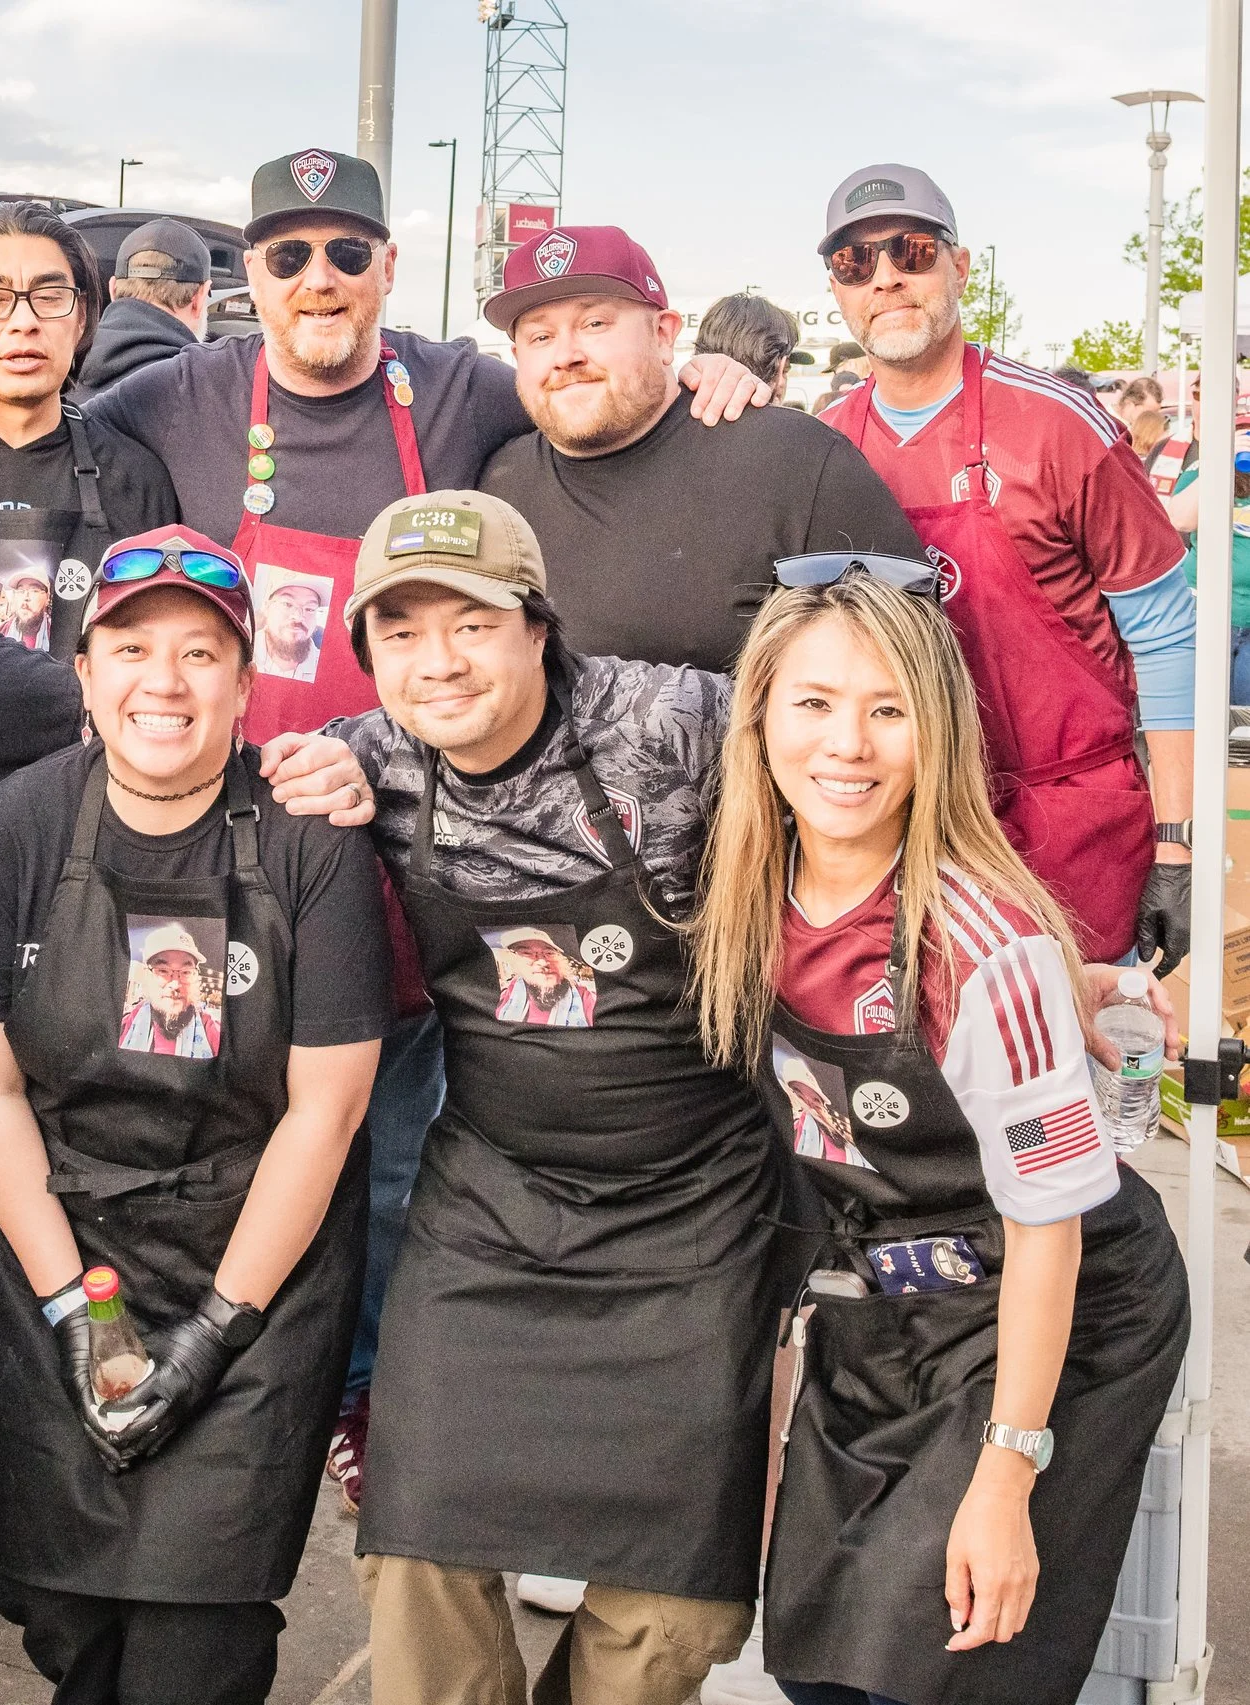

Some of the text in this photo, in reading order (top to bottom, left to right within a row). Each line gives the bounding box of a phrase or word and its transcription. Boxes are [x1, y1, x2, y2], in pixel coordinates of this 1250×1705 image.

[297, 157, 330, 169] COLORADO
[513, 217, 549, 231] uchealth
[538, 242, 571, 258] COLORADO
[411, 511, 456, 527] C38
[433, 535, 469, 547] RAPIDS
[67, 568, 74, 576] R
[434, 833, 460, 846] idas
[601, 936, 611, 945] R
[591, 941, 626, 955] 81 26
[228, 954, 236, 963] R
[605, 954, 613, 963] S
[239, 962, 251, 971] 26
[231, 975, 237, 984] S
[865, 1005, 895, 1024] COLORA
[873, 1093, 883, 1102] R
[862, 1102, 873, 1110] 81
[878, 1111, 886, 1120] S
